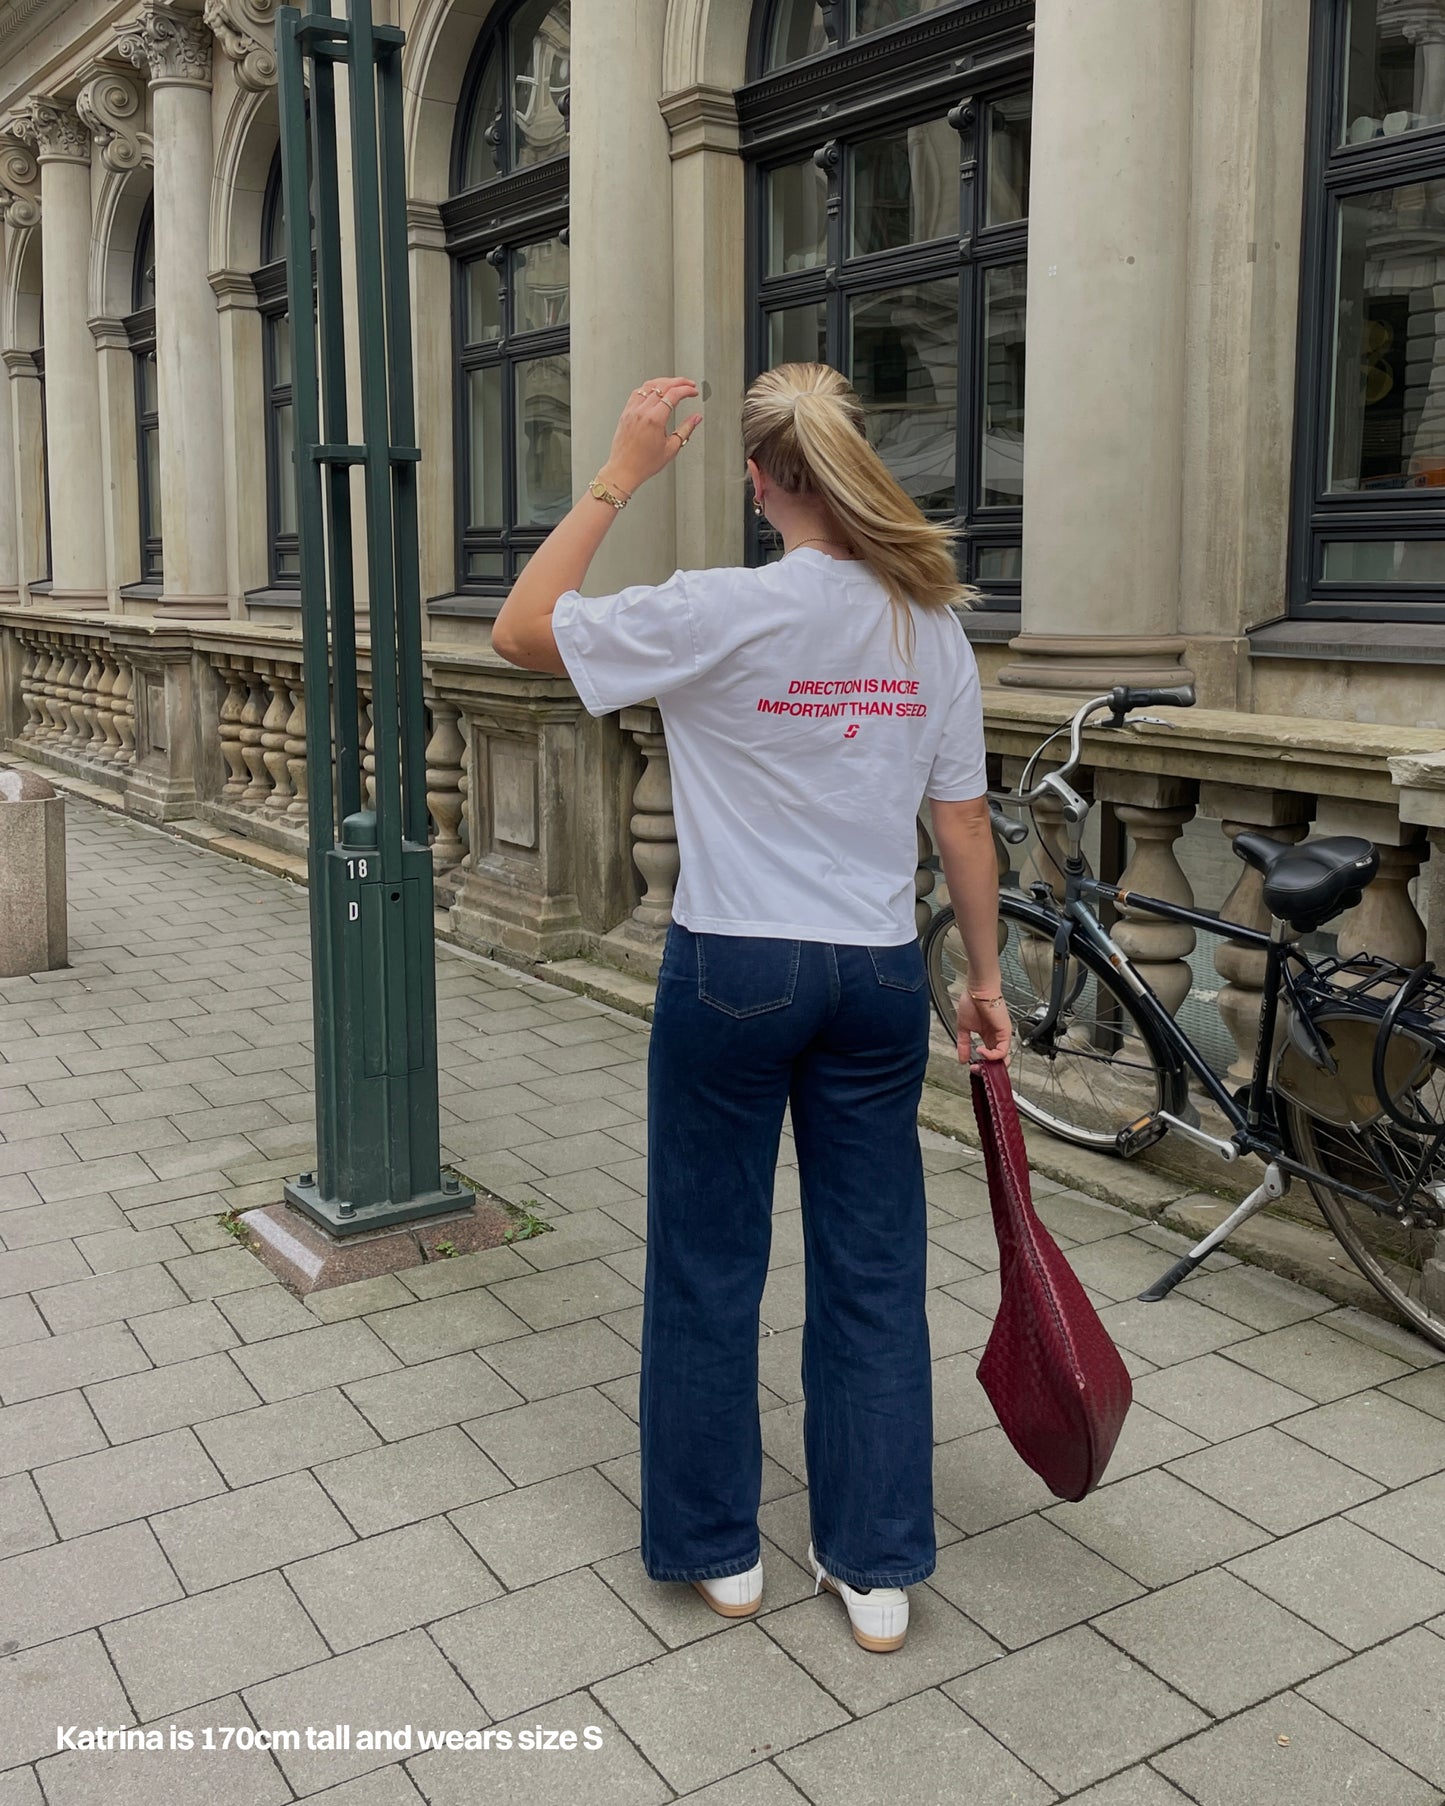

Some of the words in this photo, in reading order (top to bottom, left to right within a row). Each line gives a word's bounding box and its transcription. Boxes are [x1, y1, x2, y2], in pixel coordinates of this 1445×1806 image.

[788, 679, 862, 696] DIRECTION
[863, 678, 879, 694] IS
[757, 698, 848, 718] IMPORTANT
[849, 701, 893, 717] THAN
[346, 858, 368, 880] 18
[348, 901, 359, 921] D
